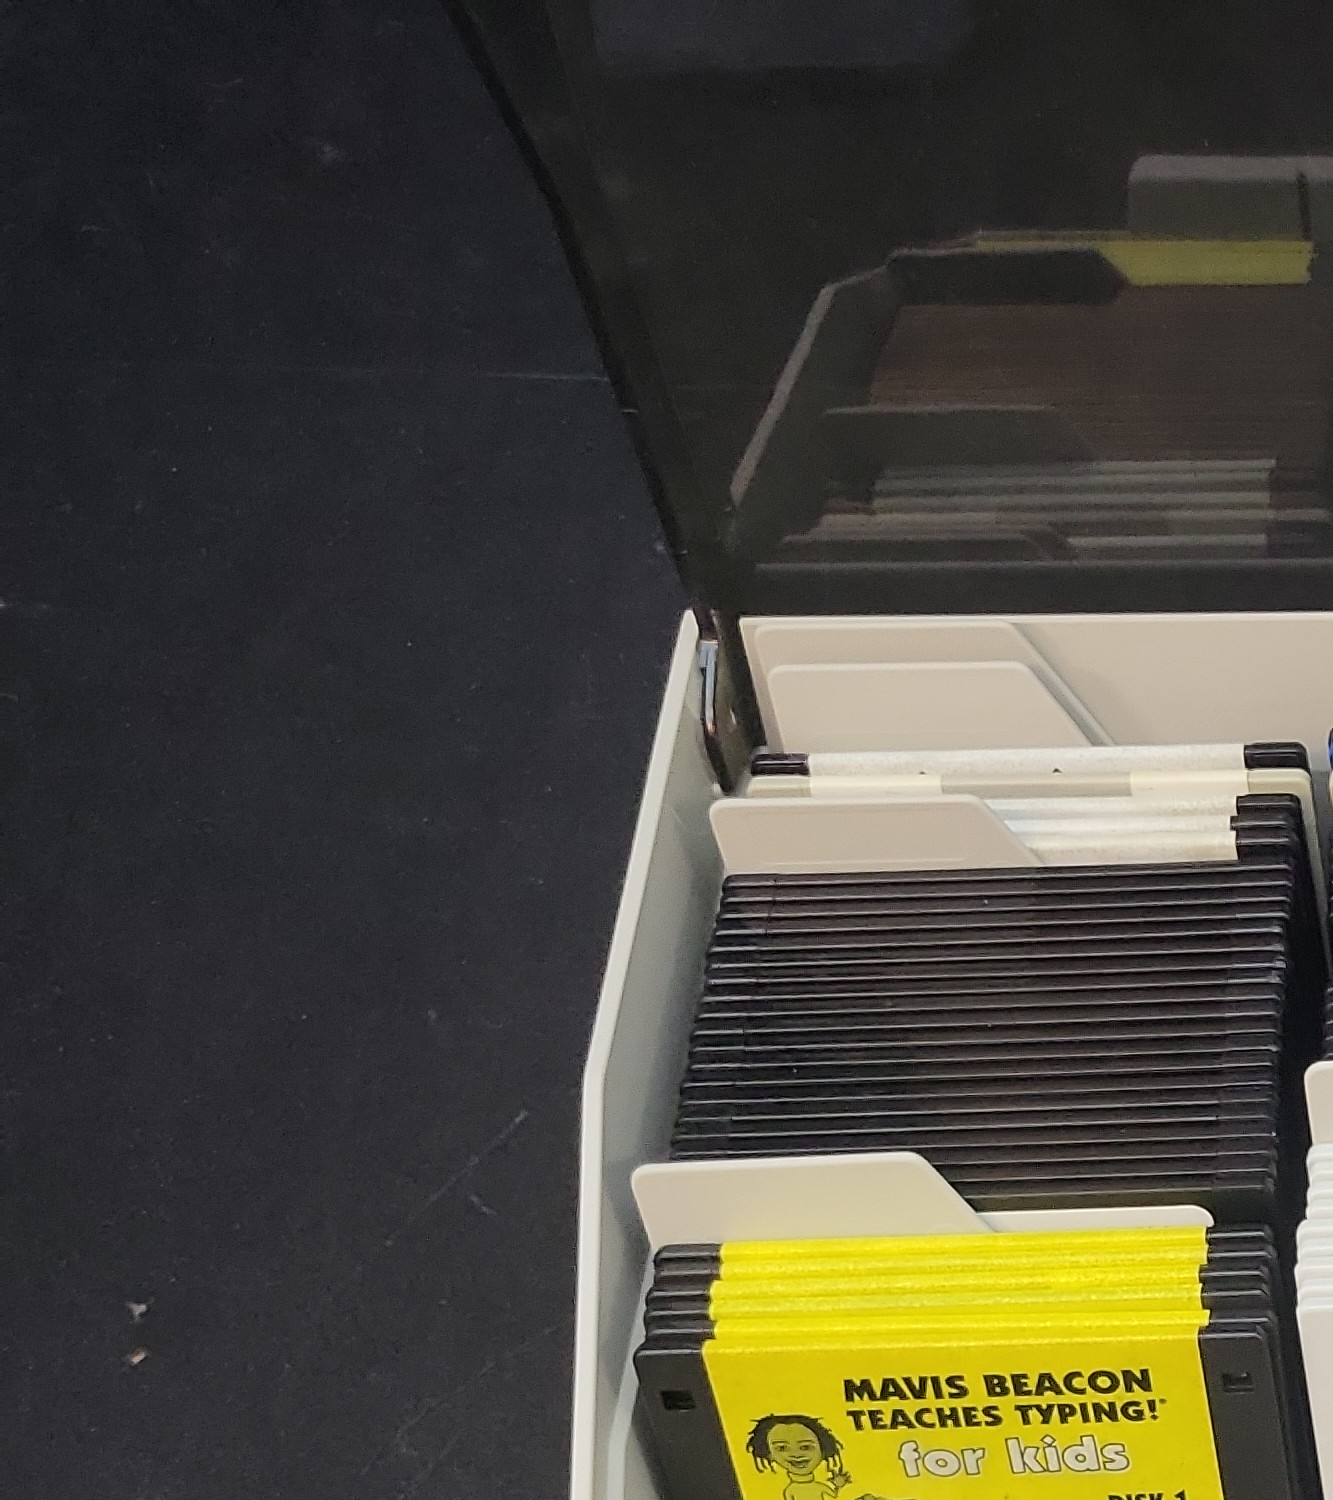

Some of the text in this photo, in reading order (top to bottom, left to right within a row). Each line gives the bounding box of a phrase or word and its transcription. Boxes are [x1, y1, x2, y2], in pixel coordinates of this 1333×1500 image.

[843, 1368, 1153, 1402] MAVIS BEACON
[846, 1399, 1160, 1431] TEACHES TYPING!
[898, 1434, 1130, 1478] for kids
